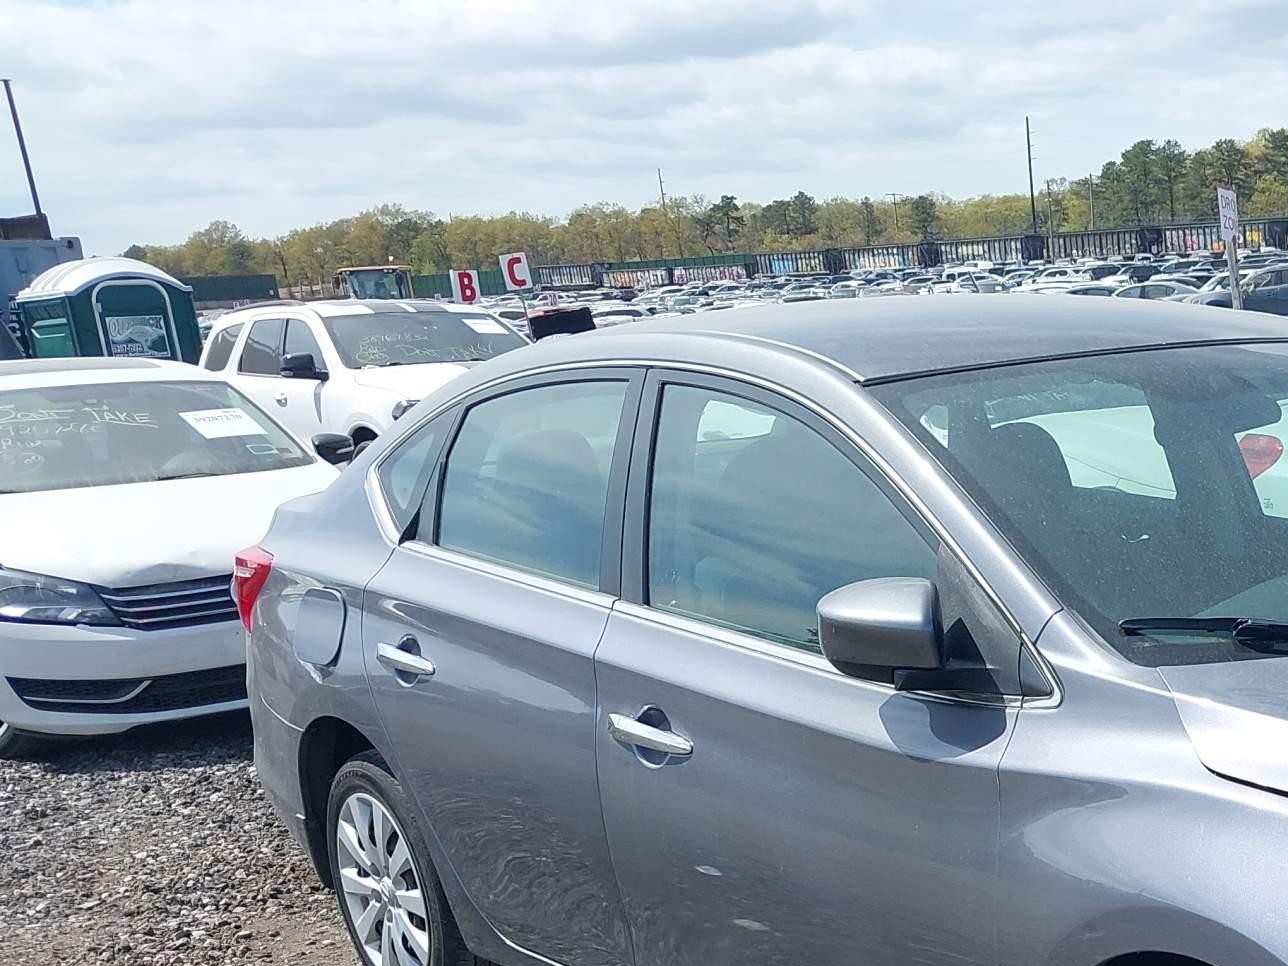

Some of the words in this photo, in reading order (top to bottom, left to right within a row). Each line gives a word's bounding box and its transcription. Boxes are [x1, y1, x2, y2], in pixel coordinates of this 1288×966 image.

[457, 271, 477, 304] B
[507, 256, 527, 288] C
[81, 405, 152, 424] TAKE
